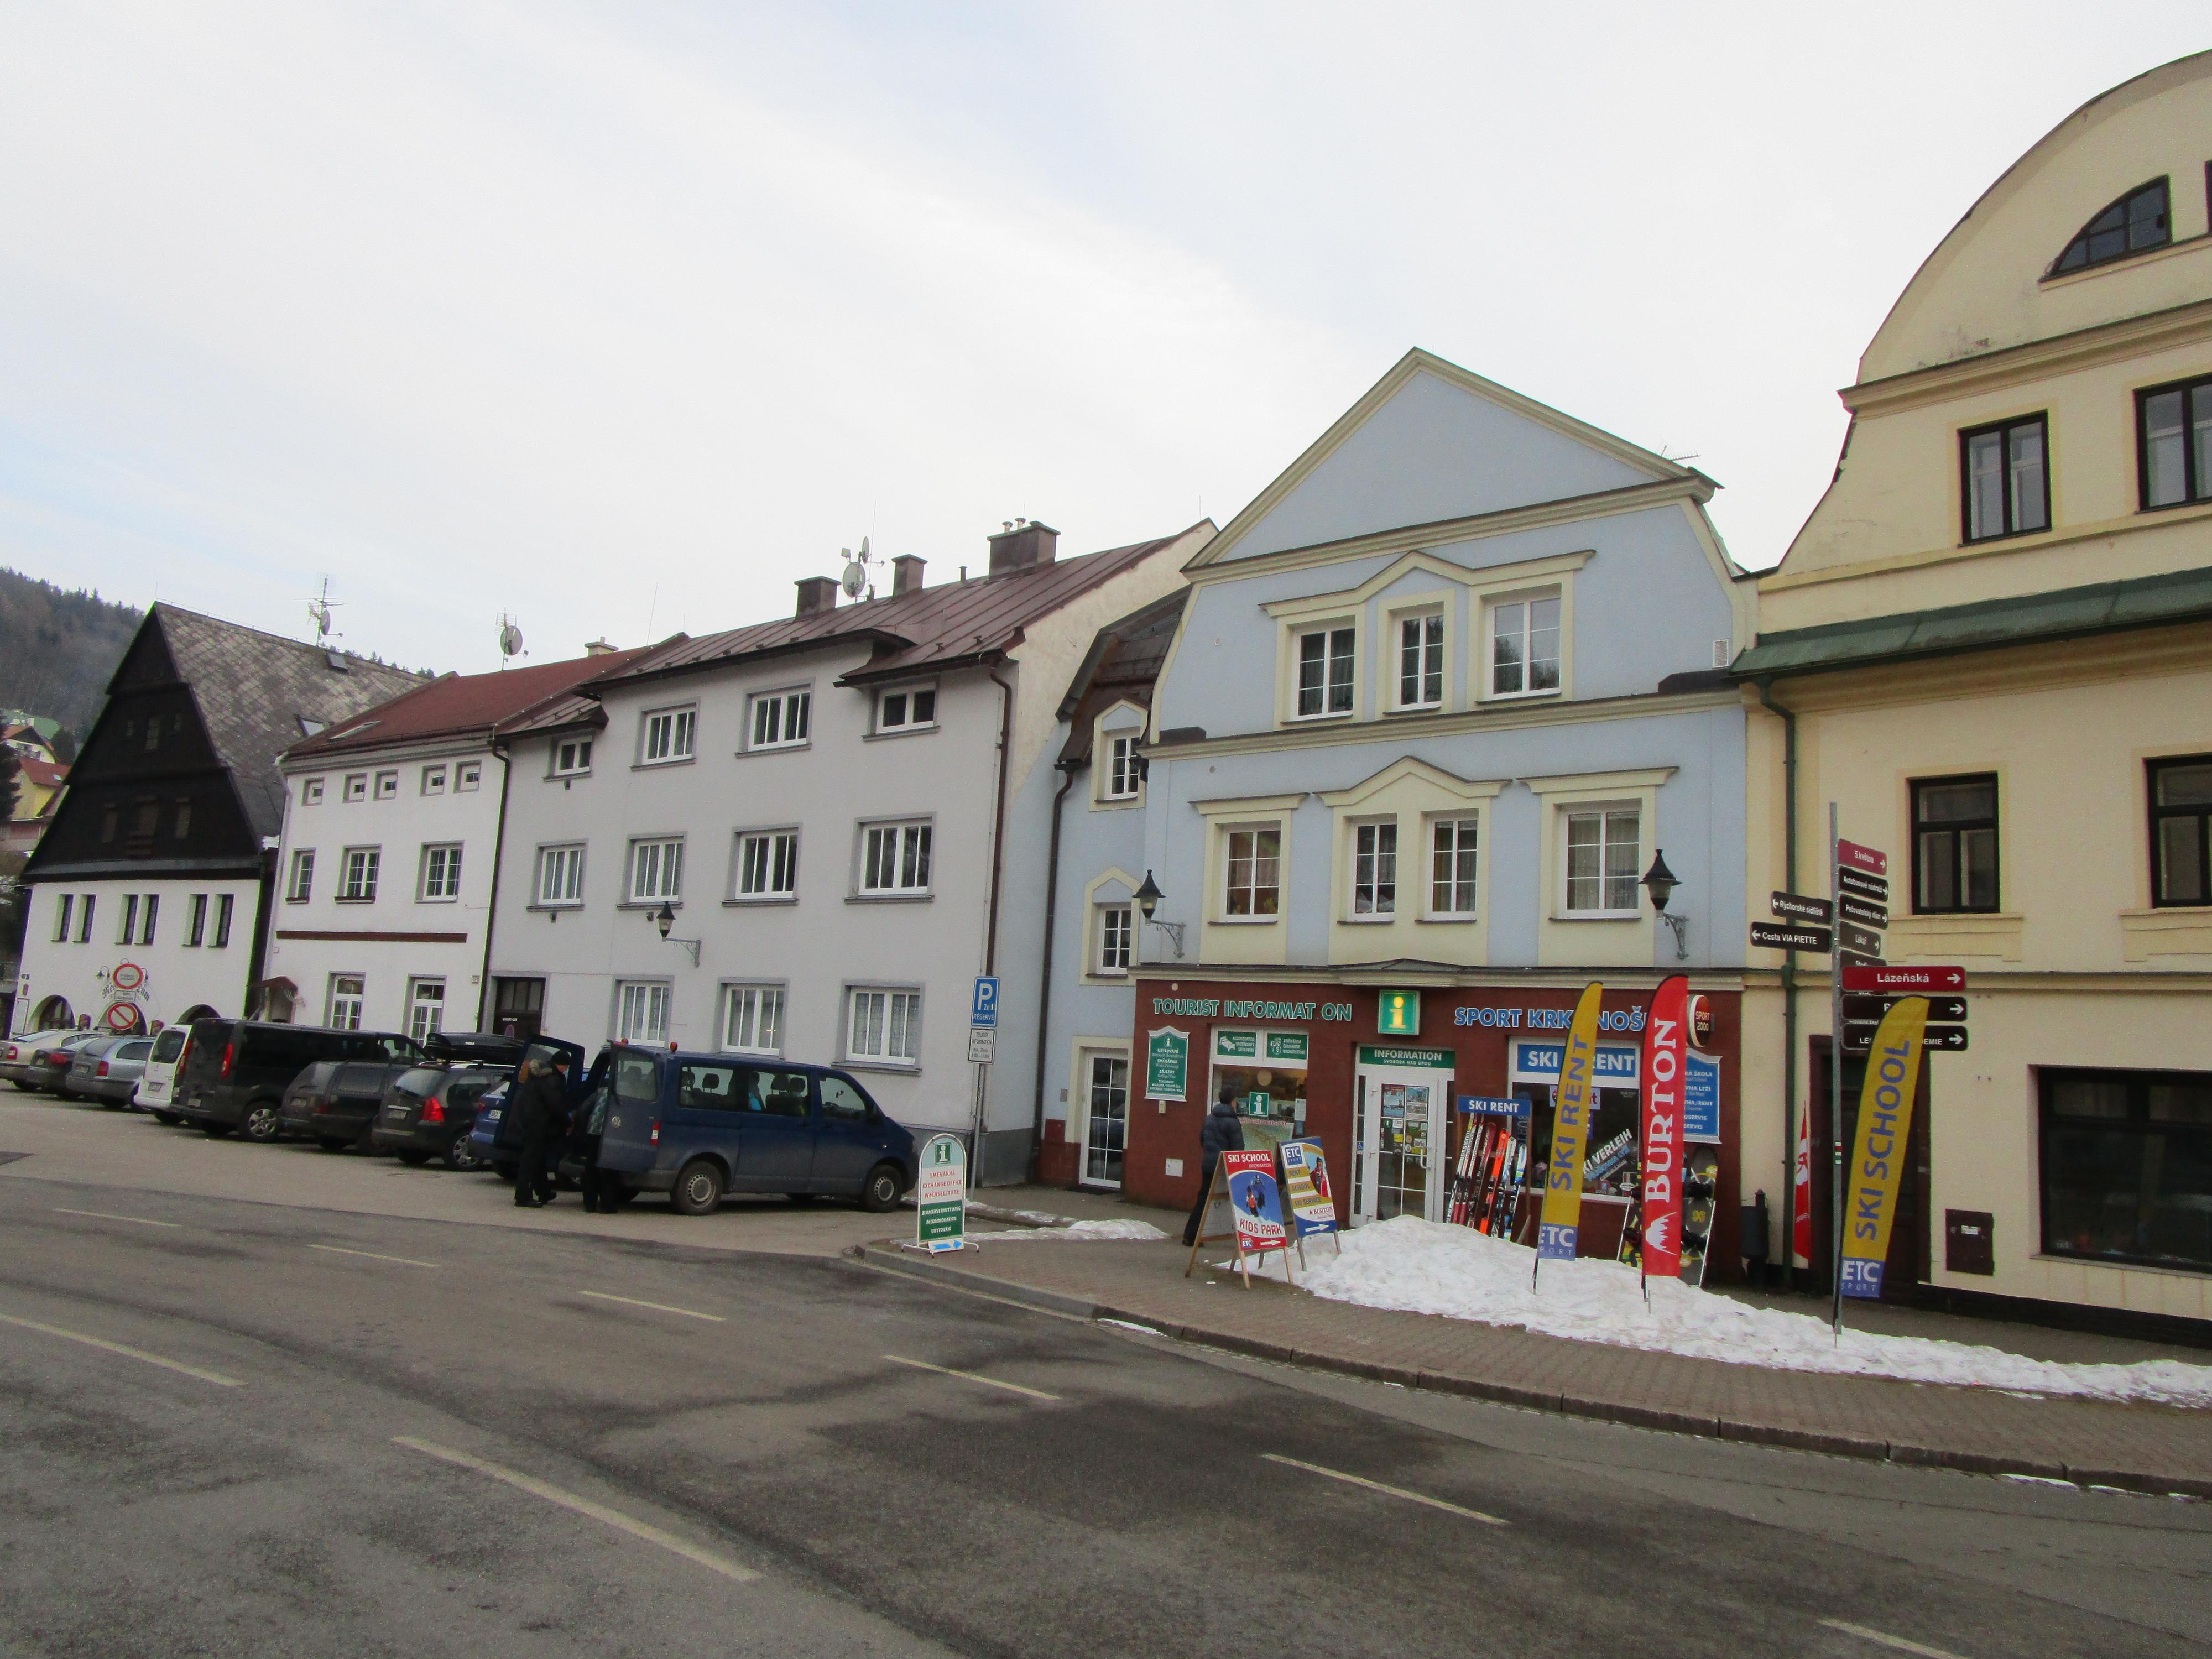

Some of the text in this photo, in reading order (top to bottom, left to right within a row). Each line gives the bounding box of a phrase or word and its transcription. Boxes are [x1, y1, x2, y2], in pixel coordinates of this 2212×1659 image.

[1762, 932, 1818, 945] Cesta VIA PIETTE
[1877, 973, 1929, 983] Lázeňská
[978, 983, 993, 1010] P
[1153, 998, 1219, 1016] TOURIST
[1454, 1006, 1647, 1032] SPORT KRKNOŠ
[1695, 1011, 1710, 1020] SPORT
[1697, 1022, 1709, 1031] 2000
[1374, 1049, 1442, 1061] INFORMATION
[1528, 1051, 1558, 1067] SKI
[1469, 1100, 1519, 1113] SKI RENT
[1550, 1034, 1589, 1191] SKI RENT
[1645, 1018, 1677, 1203] BURTON
[1856, 1040, 1910, 1240] SKI SCHOOL
[1592, 1128, 1632, 1165] VERLEIH
[1228, 1153, 1271, 1163] SKI SCHOOL
[1286, 1147, 1301, 1159] ETC
[922, 1181, 946, 1189] EXCHANGE
[1292, 1183, 1310, 1191] SCHOOL
[924, 1190, 959, 1198] WECHSELSTUBE
[1303, 1197, 1322, 1205] SERVICE
[1313, 1207, 1333, 1215] BURTON
[1240, 1218, 1282, 1235] KIDS PARK
[1842, 1260, 1880, 1283] ETC
[1840, 1282, 1876, 1292] SPORT
